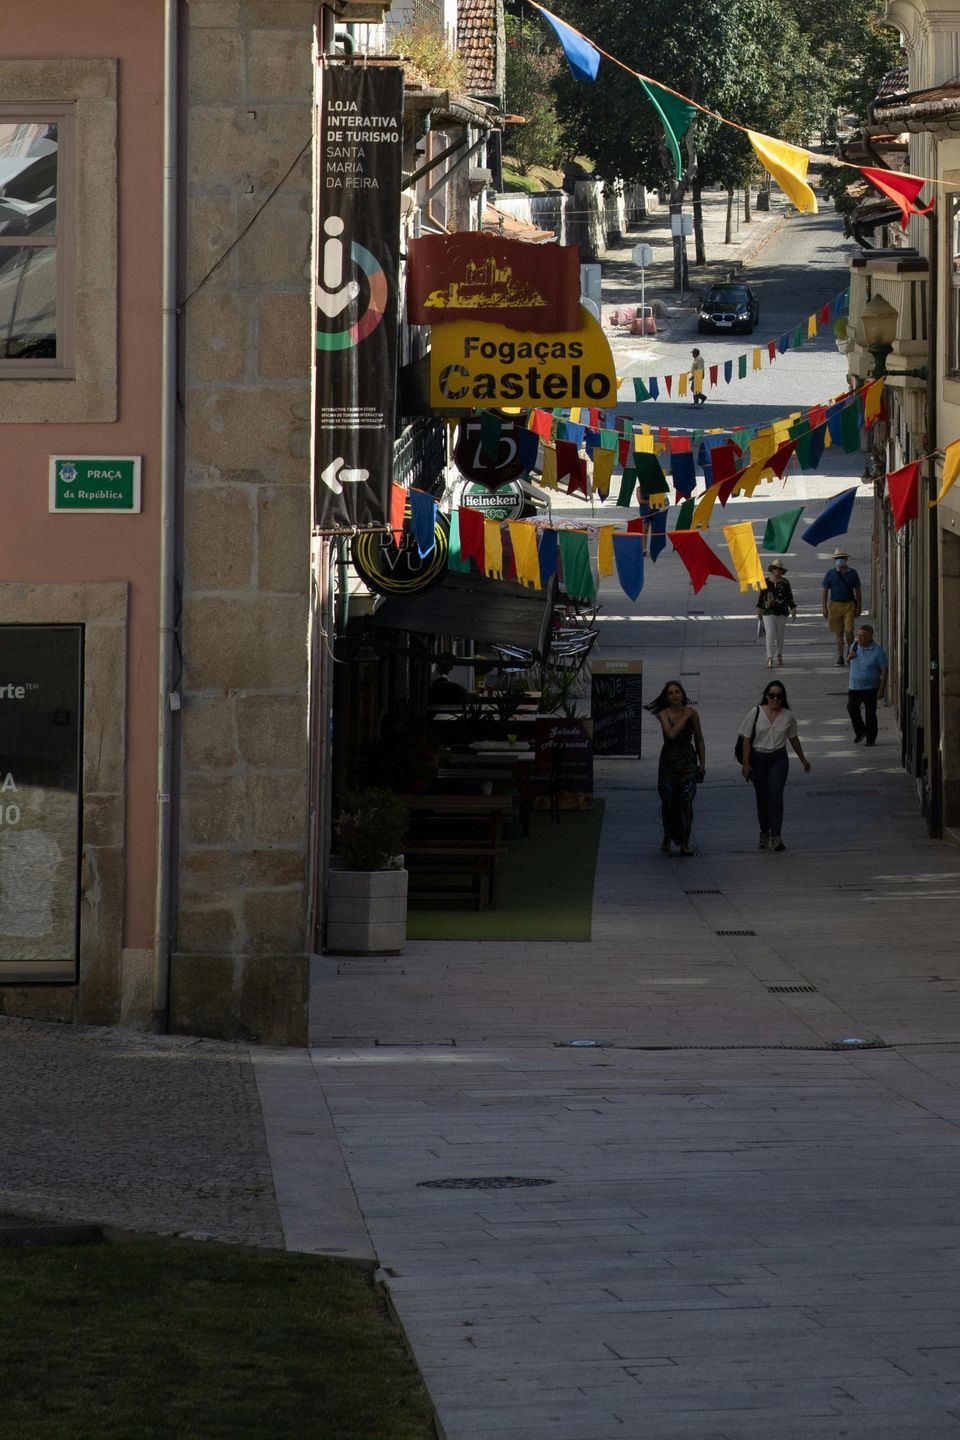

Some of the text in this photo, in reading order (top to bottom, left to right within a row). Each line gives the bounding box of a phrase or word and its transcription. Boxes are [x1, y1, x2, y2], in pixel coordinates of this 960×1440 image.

[328, 101, 358, 111] LOJA
[327, 116, 397, 127] INTERATIVA
[327, 131, 399, 143] DE TURISMO
[326, 146, 365, 158] SANTA
[326, 162, 363, 173] MARIA
[326, 177, 379, 189] DA FEIRA
[464, 336, 584, 365] Fogaças
[438, 364, 611, 400] Castelo
[87, 470, 122, 480] PRAÇA
[64, 490, 123, 500] da República
[465, 495, 517, 506] Heineken
[379, 532, 418, 549] DJ
[381, 548, 424, 571] VU
[0, 772, 18, 792] A
